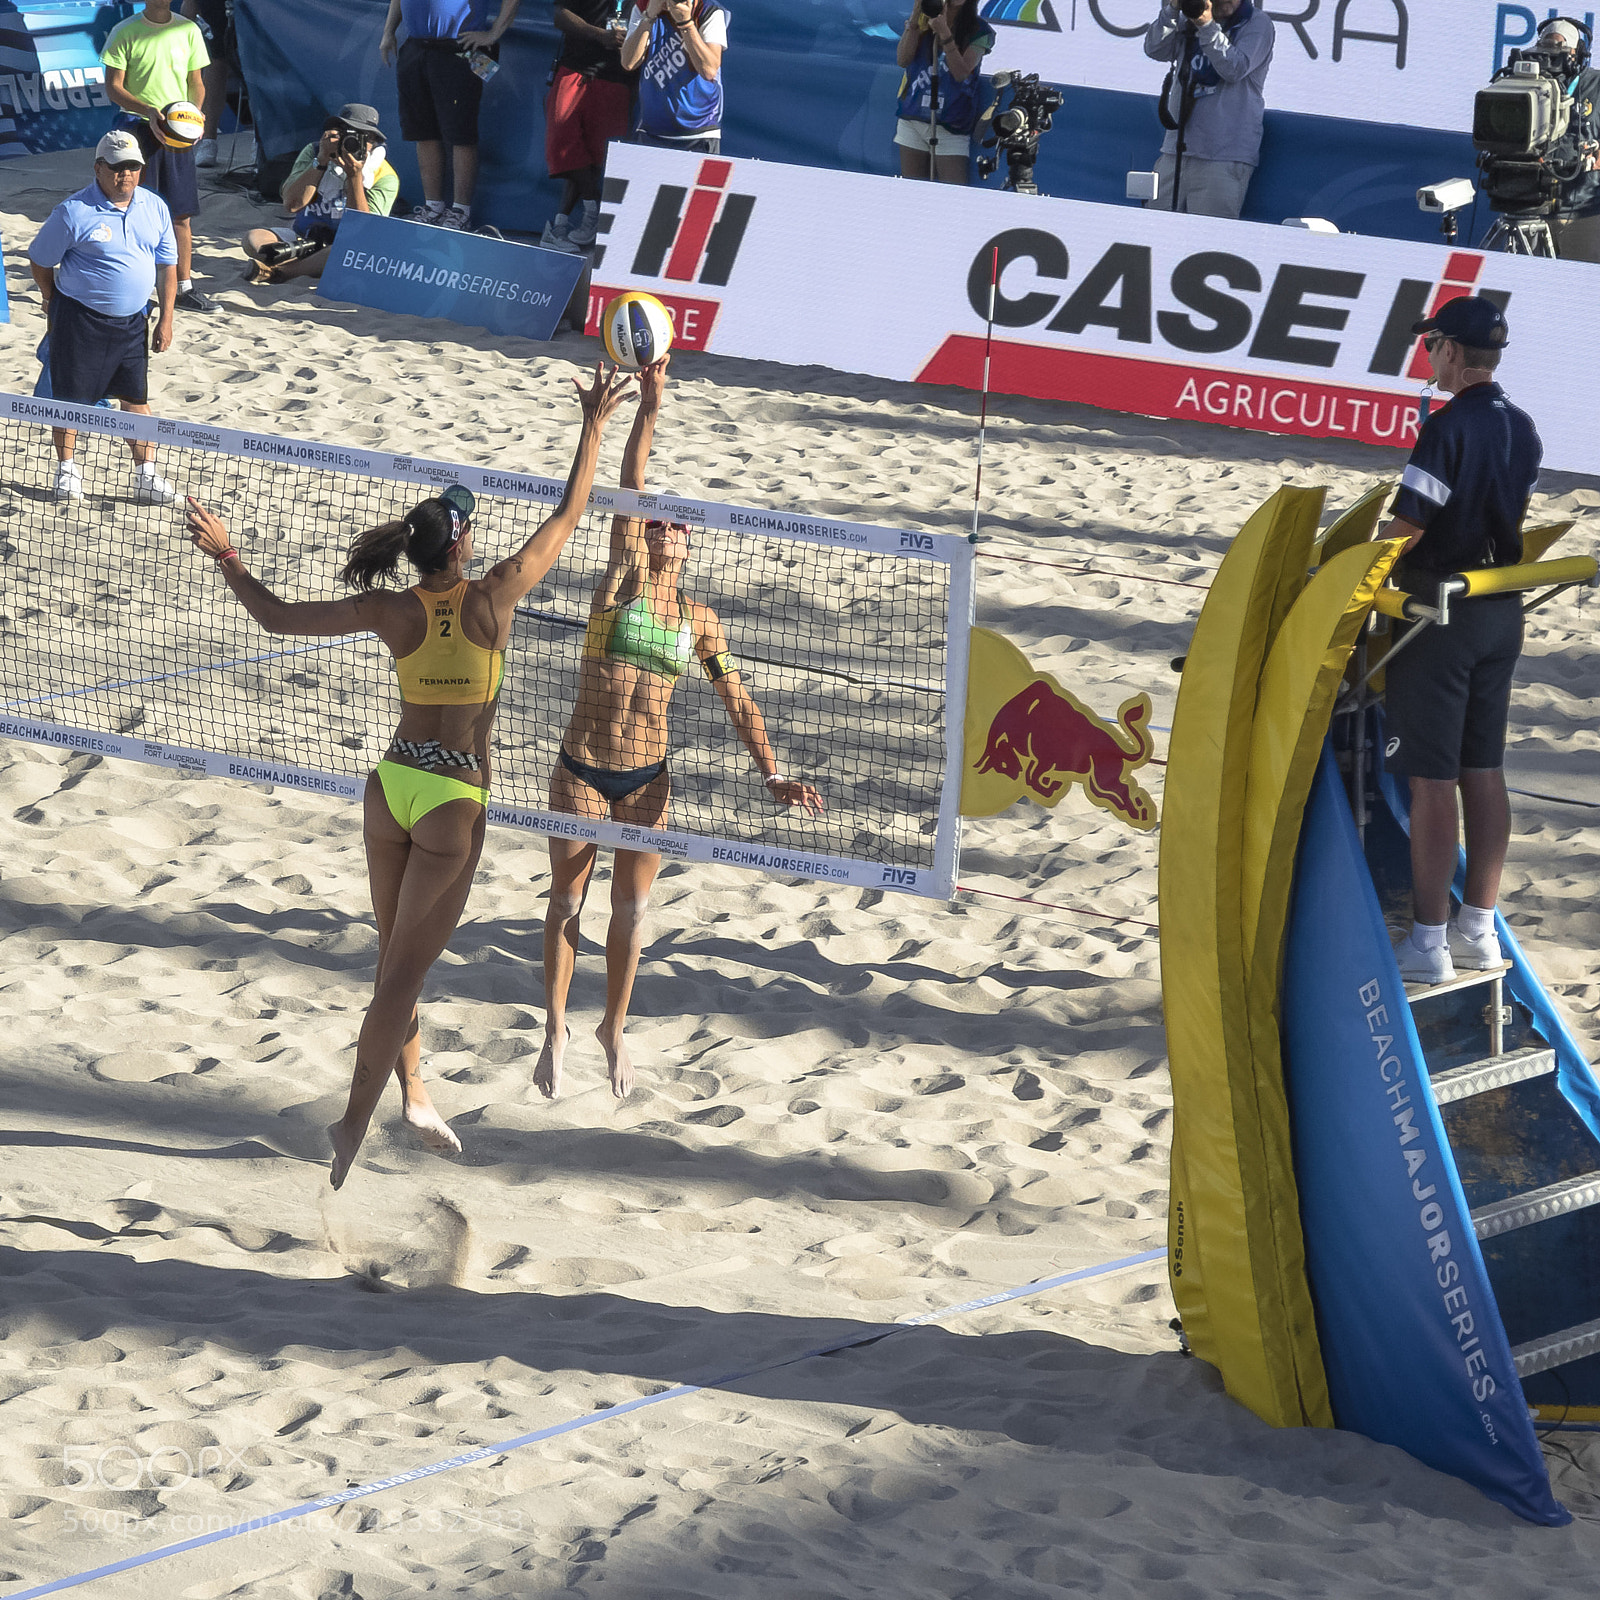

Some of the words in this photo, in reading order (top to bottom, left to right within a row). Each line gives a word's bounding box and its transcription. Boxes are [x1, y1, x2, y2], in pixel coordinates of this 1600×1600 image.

[643, 31, 684, 80] OFFICIAL
[342, 249, 553, 308] BEACHMAJORSERIES.COM
[966, 227, 1366, 369] CASE
[11, 401, 135, 432] BEACHMAJORSERIES.COM
[1175, 377, 1421, 440] AGRICULTUR
[157, 426, 176, 435] FORT
[177, 428, 221, 442] LAUDERDALE
[243, 438, 370, 469] BEACHMAJORSERIES.COM
[393, 462, 412, 471] FORT
[413, 466, 459, 479] LAUDERDALE
[482, 475, 614, 506] BEACHMAJORSS.COM
[638, 500, 657, 509] FORT
[659, 503, 706, 517] LAUDERDALE
[729, 512, 868, 544] BEACHMAJORSERIES.COM
[900, 531, 934, 550] FIVB
[435, 607, 454, 617] BRA
[439, 620, 452, 638] 2
[418, 677, 471, 686] FERNANDA
[0, 722, 122, 754] BEACHMAJORSERIES.COM
[144, 749, 162, 758] FORT
[163, 752, 207, 767] LAUDERDALE
[229, 763, 356, 796] BEACHMAJORSERIES.COM
[487, 809, 597, 839] CHMAJORSERIES.COM
[621, 833, 641, 842] FORT
[642, 836, 689, 850] LAUDERDALE
[712, 847, 850, 879] BEACHMAJORSERIES.COM
[882, 867, 917, 885] FIVB
[1358, 977, 1499, 1446] BEACHMAJORSERIES.COM
[314, 1447, 498, 1509] BEACHMAJORSERIES.COM
